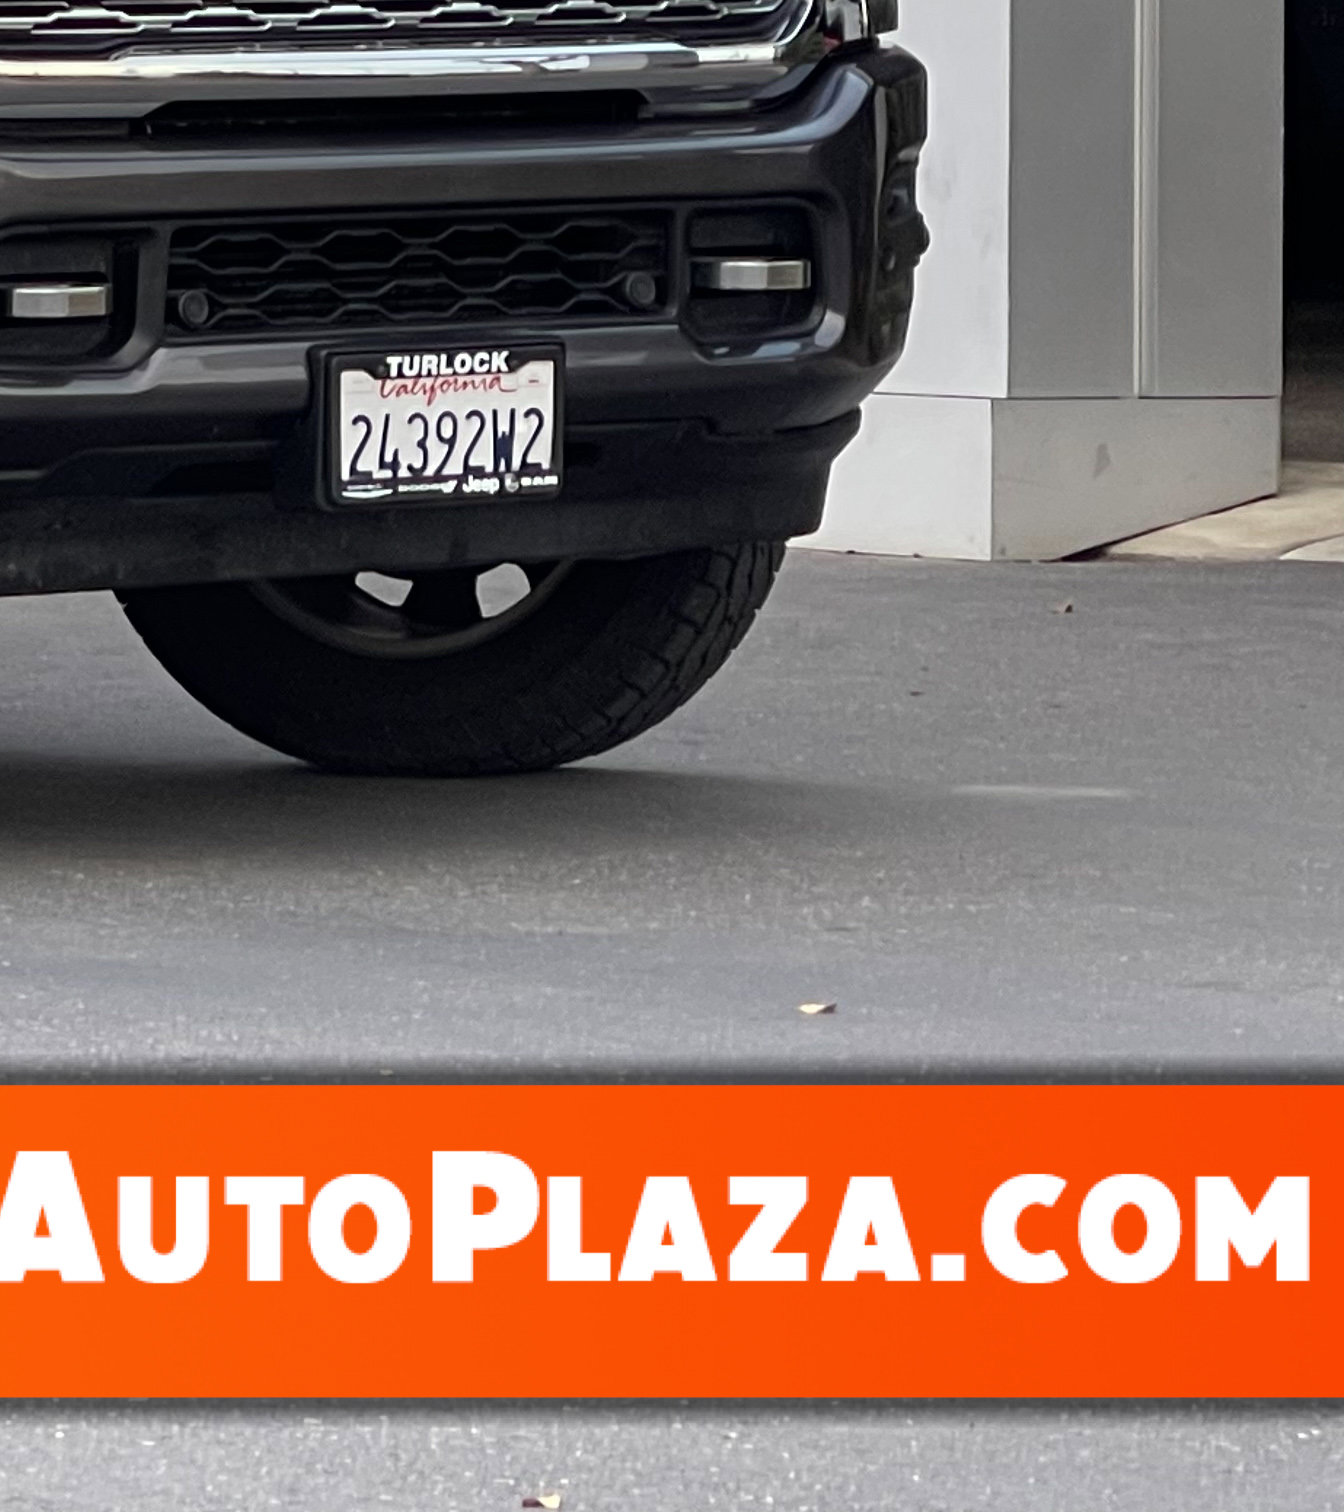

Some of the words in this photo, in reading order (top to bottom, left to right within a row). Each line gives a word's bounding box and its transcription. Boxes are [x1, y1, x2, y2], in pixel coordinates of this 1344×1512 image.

[386, 351, 510, 378] TURLOCK
[378, 374, 517, 406] California
[349, 407, 545, 480] 24392W2
